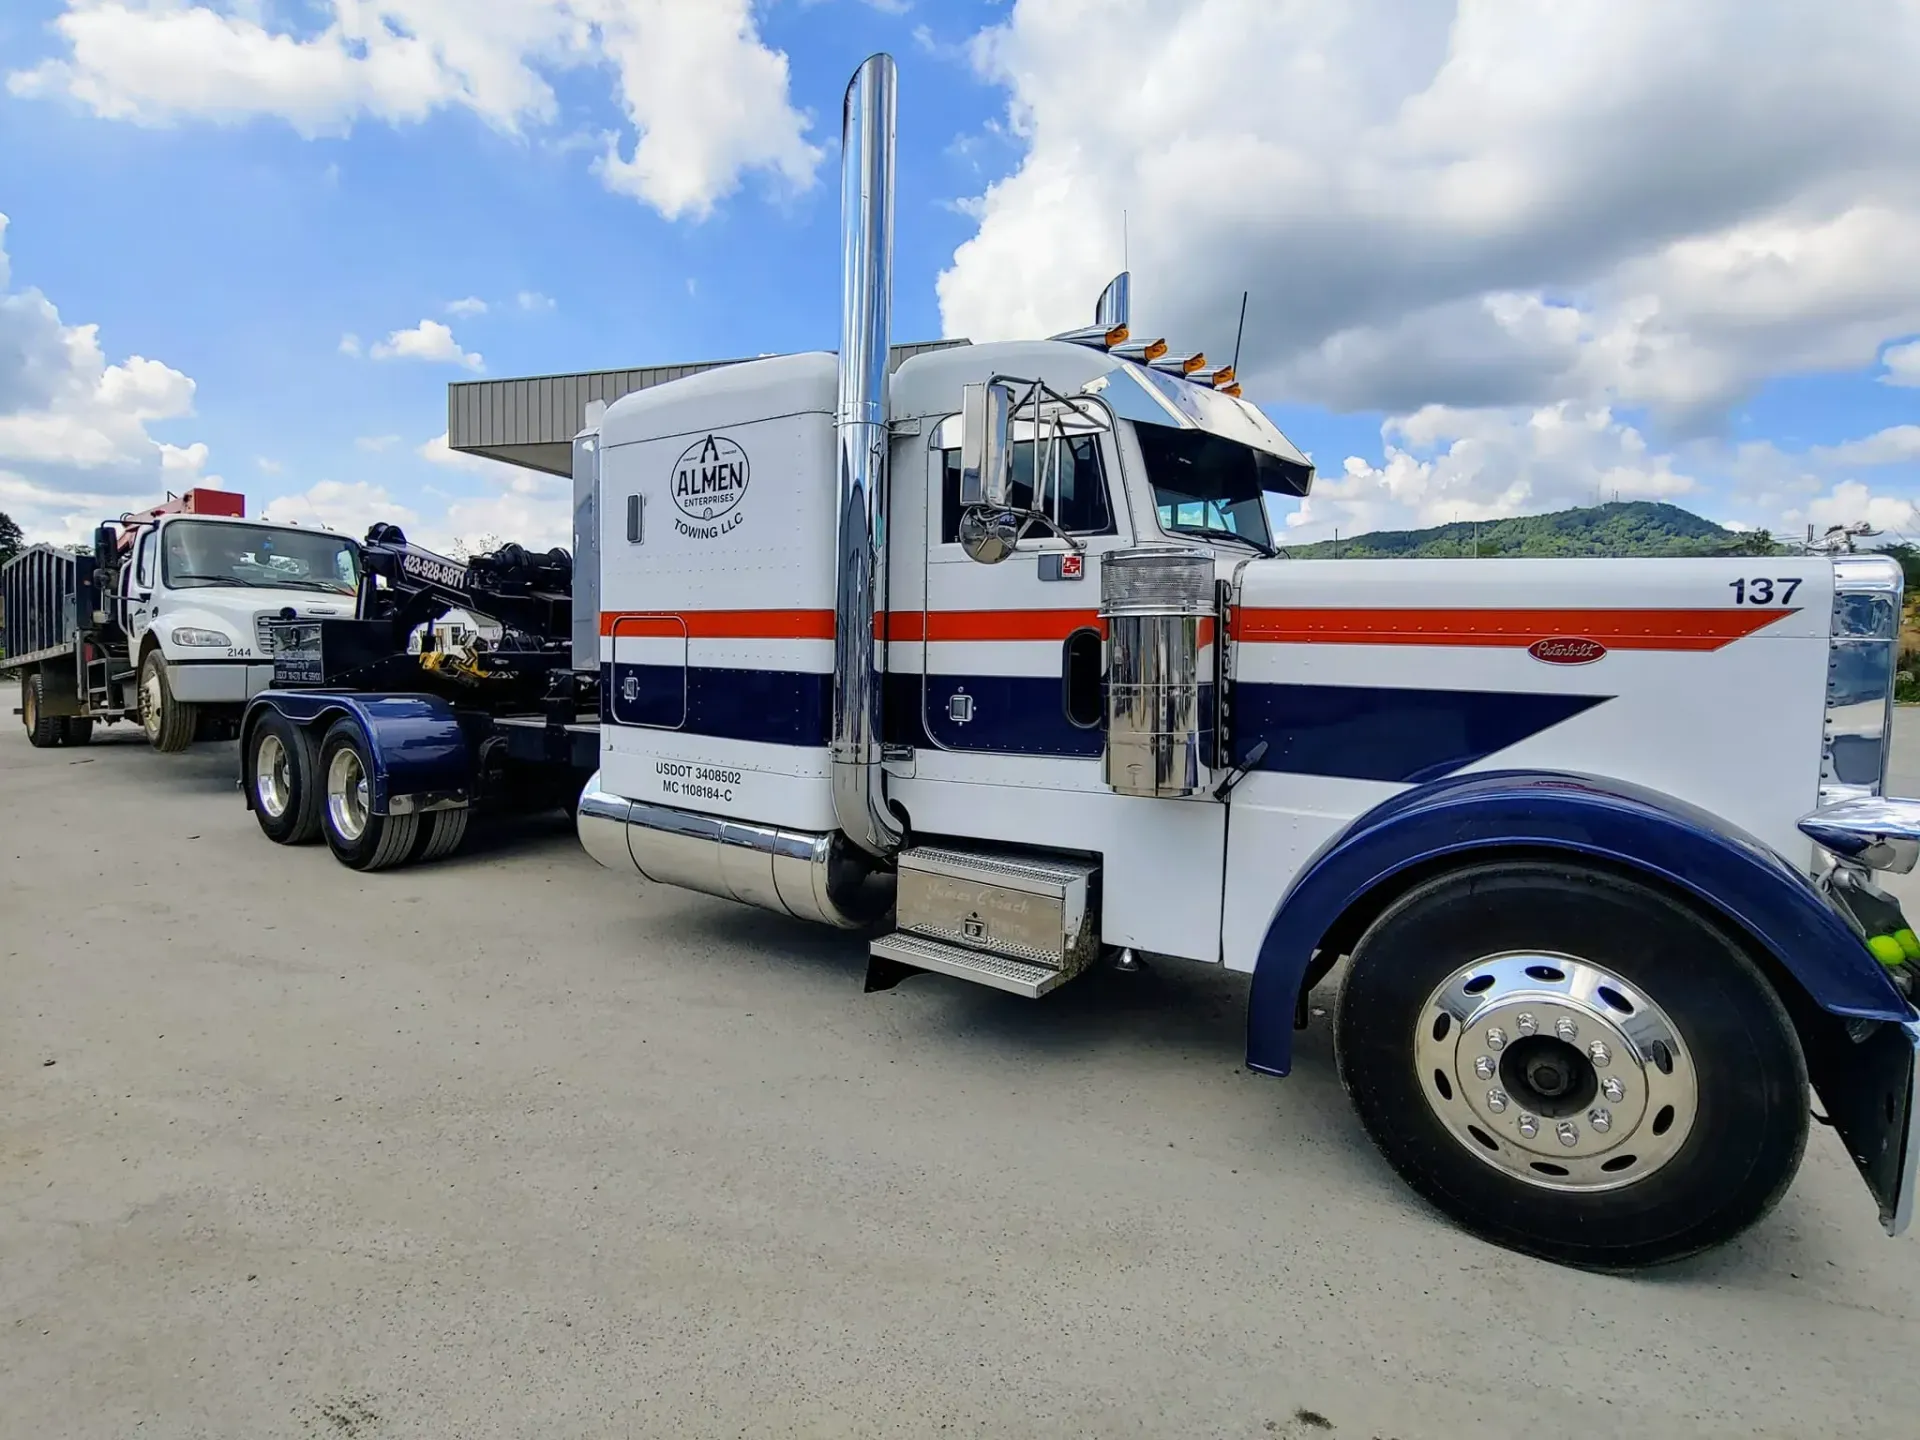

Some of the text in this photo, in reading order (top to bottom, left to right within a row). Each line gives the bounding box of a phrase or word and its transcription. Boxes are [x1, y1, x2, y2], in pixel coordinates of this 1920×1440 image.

[677, 461, 743, 497] ALMEN
[684, 493, 735, 508] ENTERPRISES
[674, 512, 744, 540] TOWING LLC
[403, 554, 465, 589] 423-928-8871
[1728, 578, 1803, 605] 137
[227, 647, 251, 657] 2144
[1537, 641, 1600, 657] Peterbilt
[656, 761, 742, 785] USDOT 3408502
[663, 779, 733, 802] MC 1108184-C
